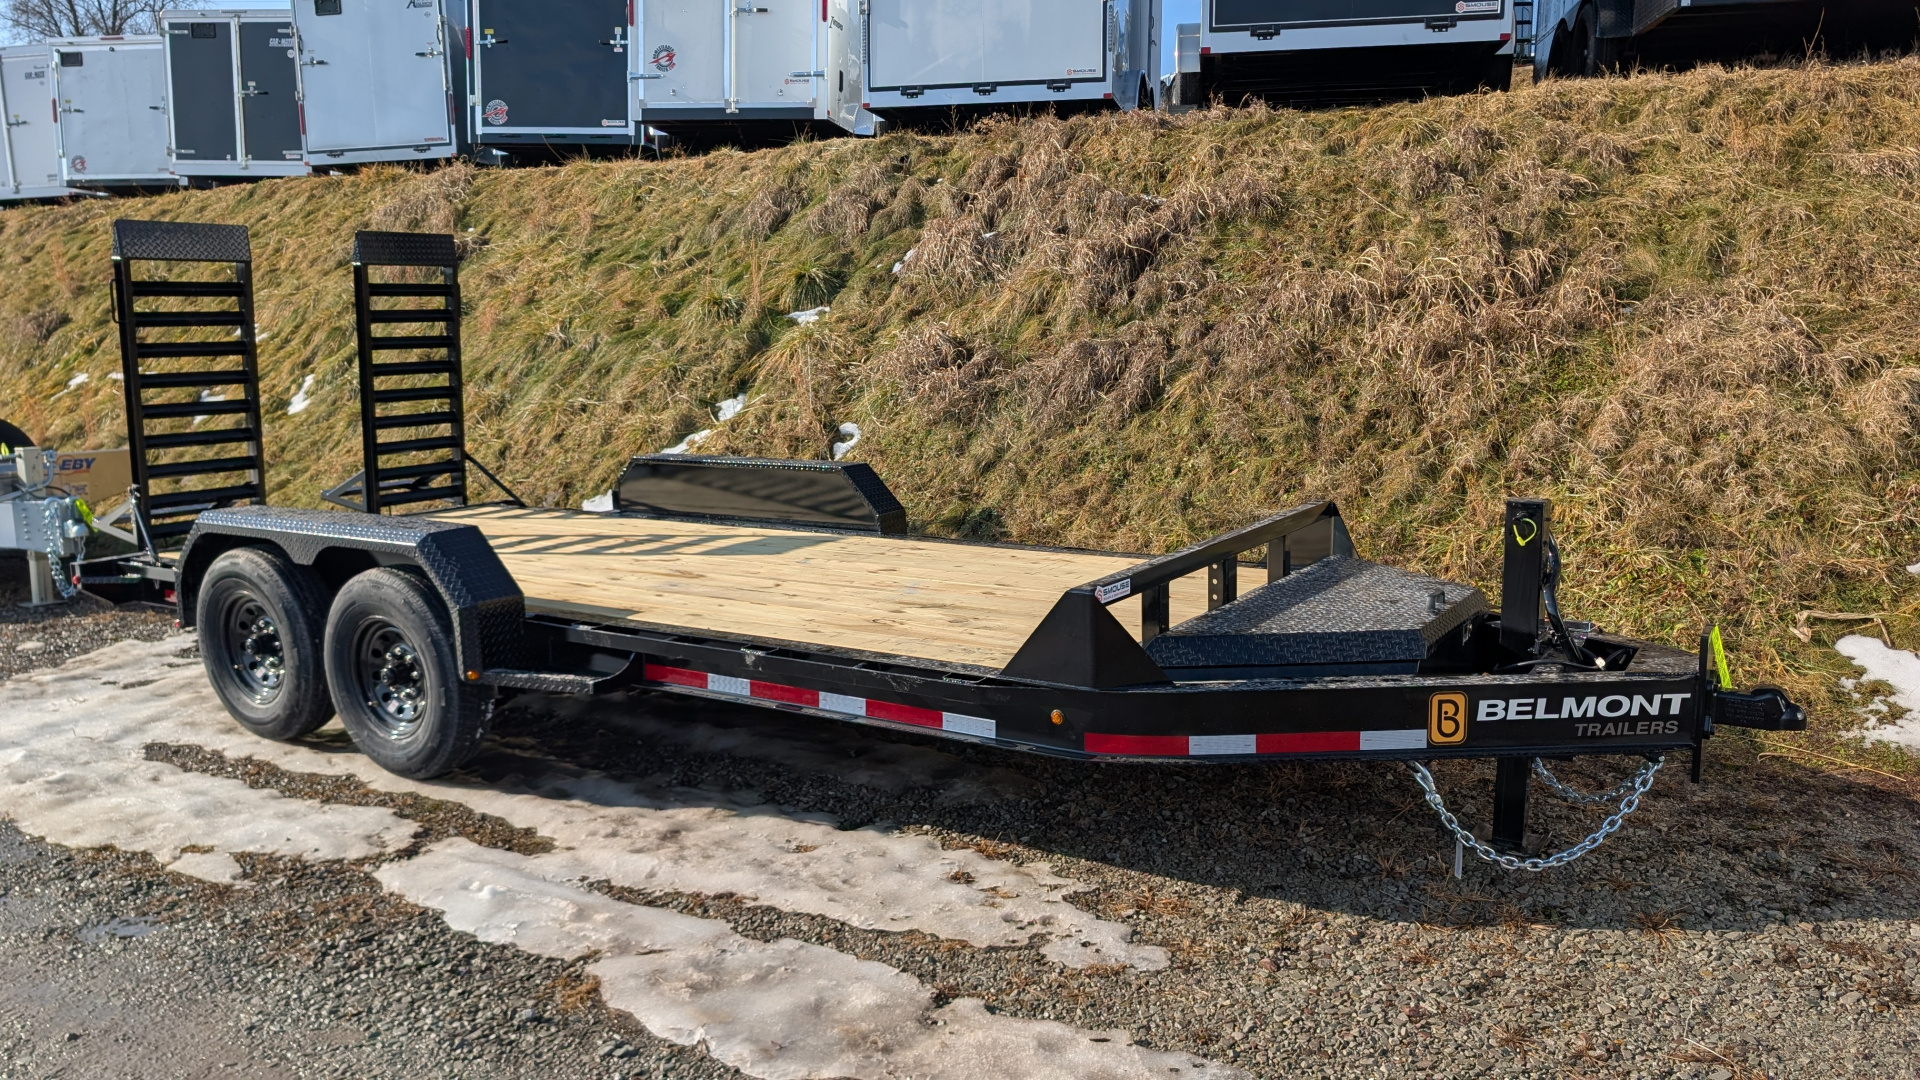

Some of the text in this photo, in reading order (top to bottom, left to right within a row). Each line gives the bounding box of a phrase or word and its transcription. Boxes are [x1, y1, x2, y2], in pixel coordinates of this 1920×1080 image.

[60, 457, 96, 470] EBY
[1103, 581, 1129, 596] SMOUSE
[1476, 693, 1691, 721] BELMONT
[1574, 720, 1679, 737] TRAILERS
